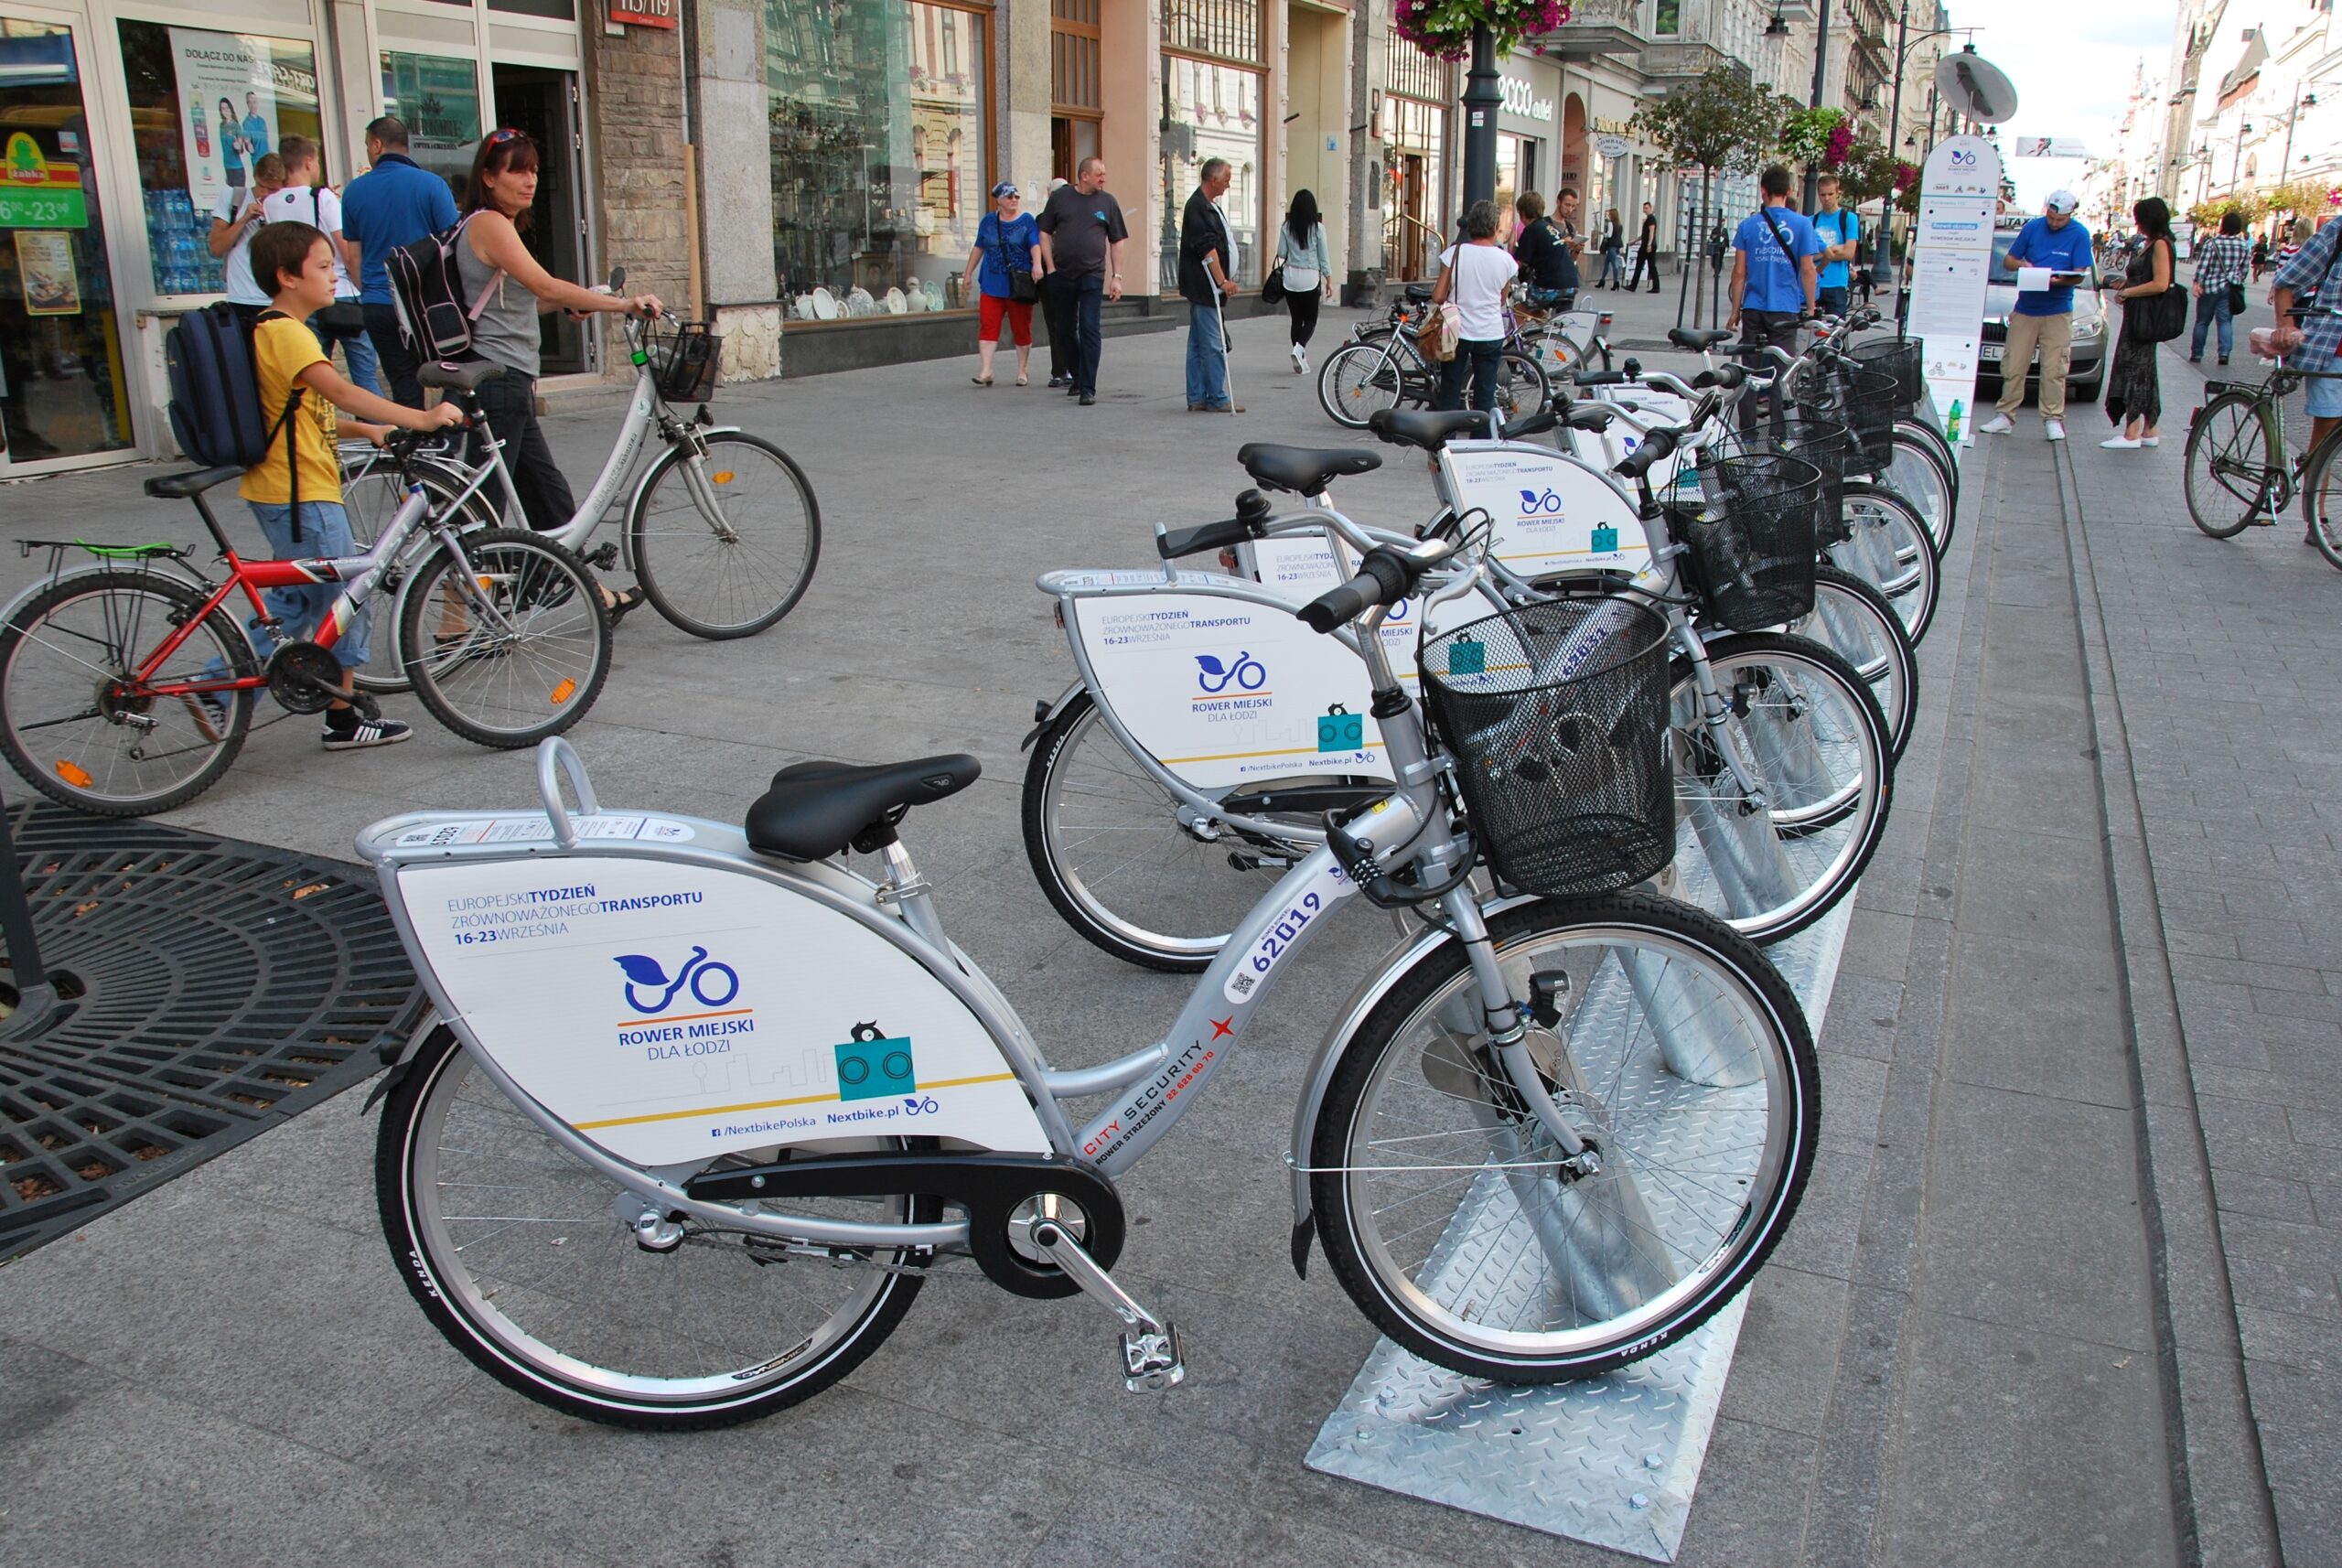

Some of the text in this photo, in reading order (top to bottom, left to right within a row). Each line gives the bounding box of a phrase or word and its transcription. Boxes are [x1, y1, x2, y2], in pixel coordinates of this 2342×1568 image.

[222, 52, 235, 62] DO
[1531, 98, 1552, 121] outlet
[2007, 217, 2031, 226] TAX
[303, 558, 360, 566] JUNIOR
[1381, 628, 1413, 637] MIEJSKI
[1382, 639, 1401, 647] ODZI
[1192, 698, 1273, 713] ROWER MIEJSKI
[1208, 710, 1257, 723] DLA ŁODZI
[1308, 757, 1352, 767] Nextbike.pl
[1252, 892, 1320, 972] 62019
[618, 1018, 755, 1047] ROWER MIEJSKI
[648, 1039, 731, 1061] DLA ŁODZI
[1083, 1039, 1202, 1156] CITY SECURITY
[1095, 1140, 1124, 1165] ROWER
[1123, 1100, 1166, 1142] STRZEŻONY
[1166, 1089, 1178, 1101] 22
[1202, 1050, 1215, 1062] 70
[724, 1105, 900, 1136] /NextbikePolska Nextbike.pl
[409, 1250, 439, 1297] KENDA
[1620, 1331, 1668, 1358] KENDA
